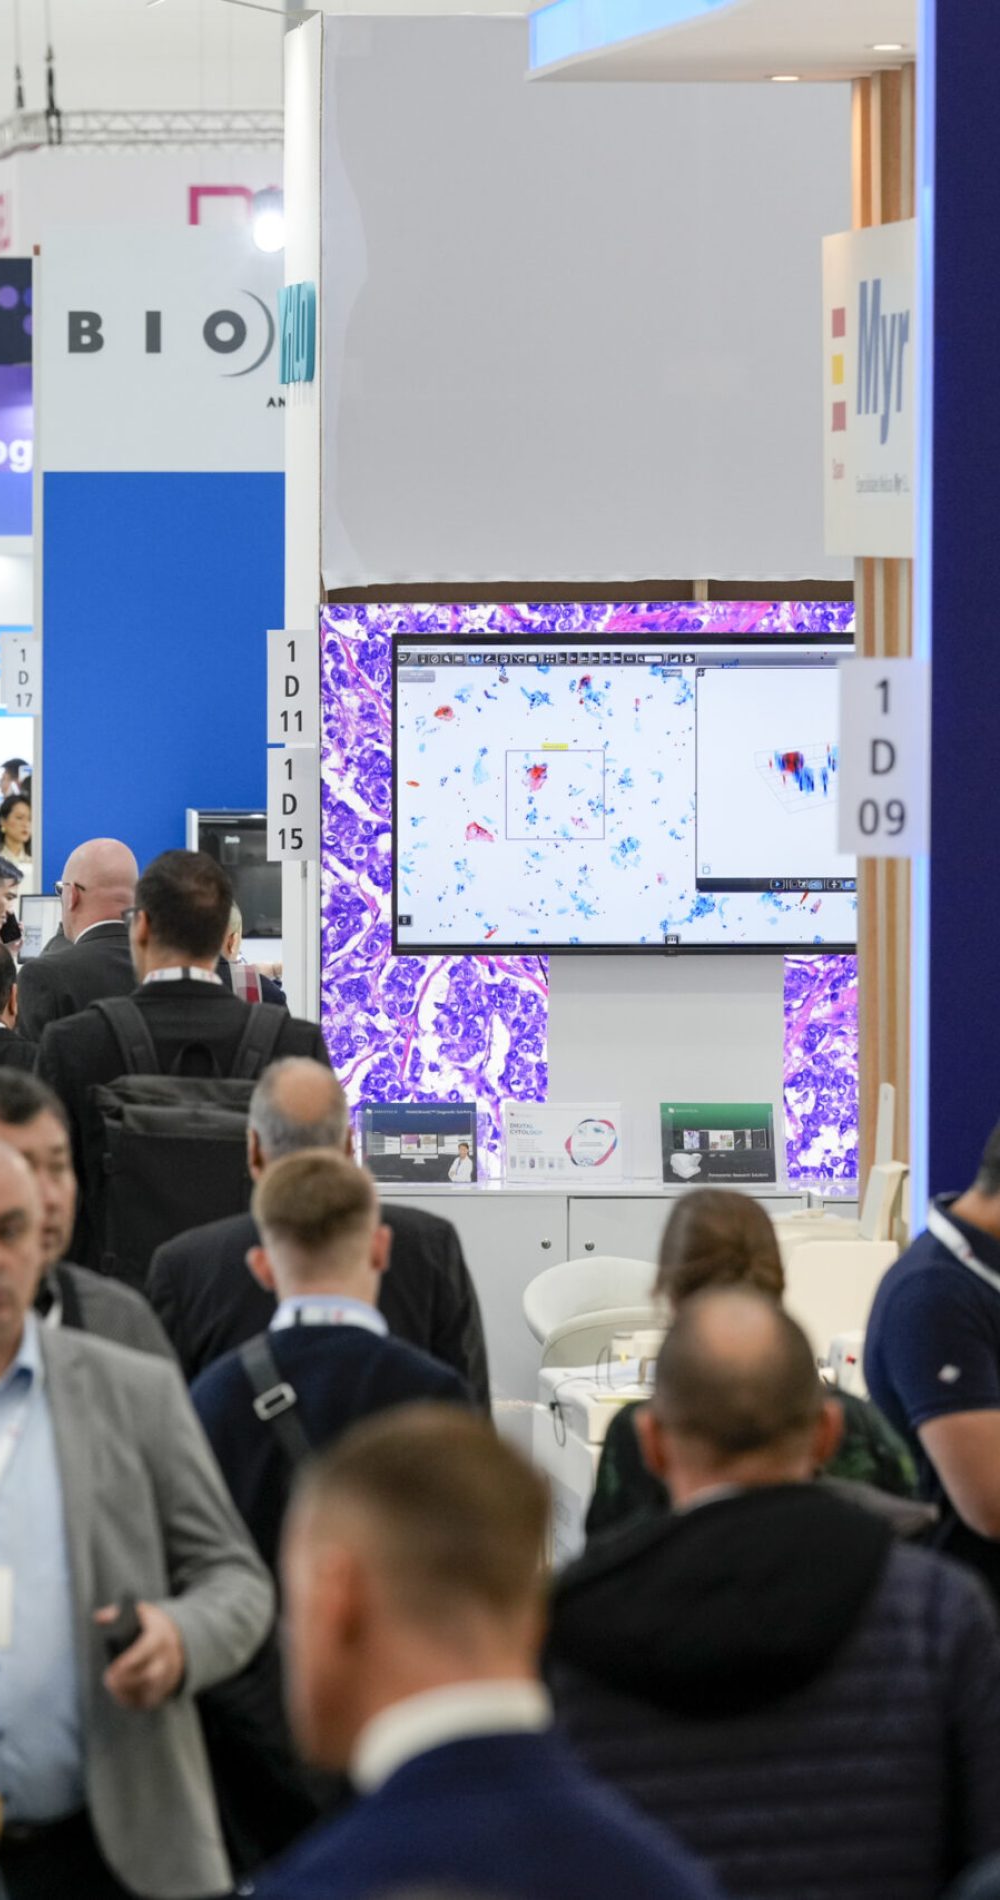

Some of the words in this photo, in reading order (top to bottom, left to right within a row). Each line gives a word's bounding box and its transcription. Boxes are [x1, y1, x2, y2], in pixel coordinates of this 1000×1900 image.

[857, 279, 909, 445] Myr
[19, 648, 26, 662] 1
[287, 640, 296, 662] 1
[18, 670, 29, 685] D
[285, 675, 300, 698] D
[16, 693, 33, 707] 17
[876, 678, 889, 715] 1
[280, 710, 303, 733] 11
[871, 738, 896, 775] D
[284, 758, 293, 780] 1
[282, 793, 298, 816] D
[858, 799, 906, 836] 09
[278, 827, 304, 850] 15
